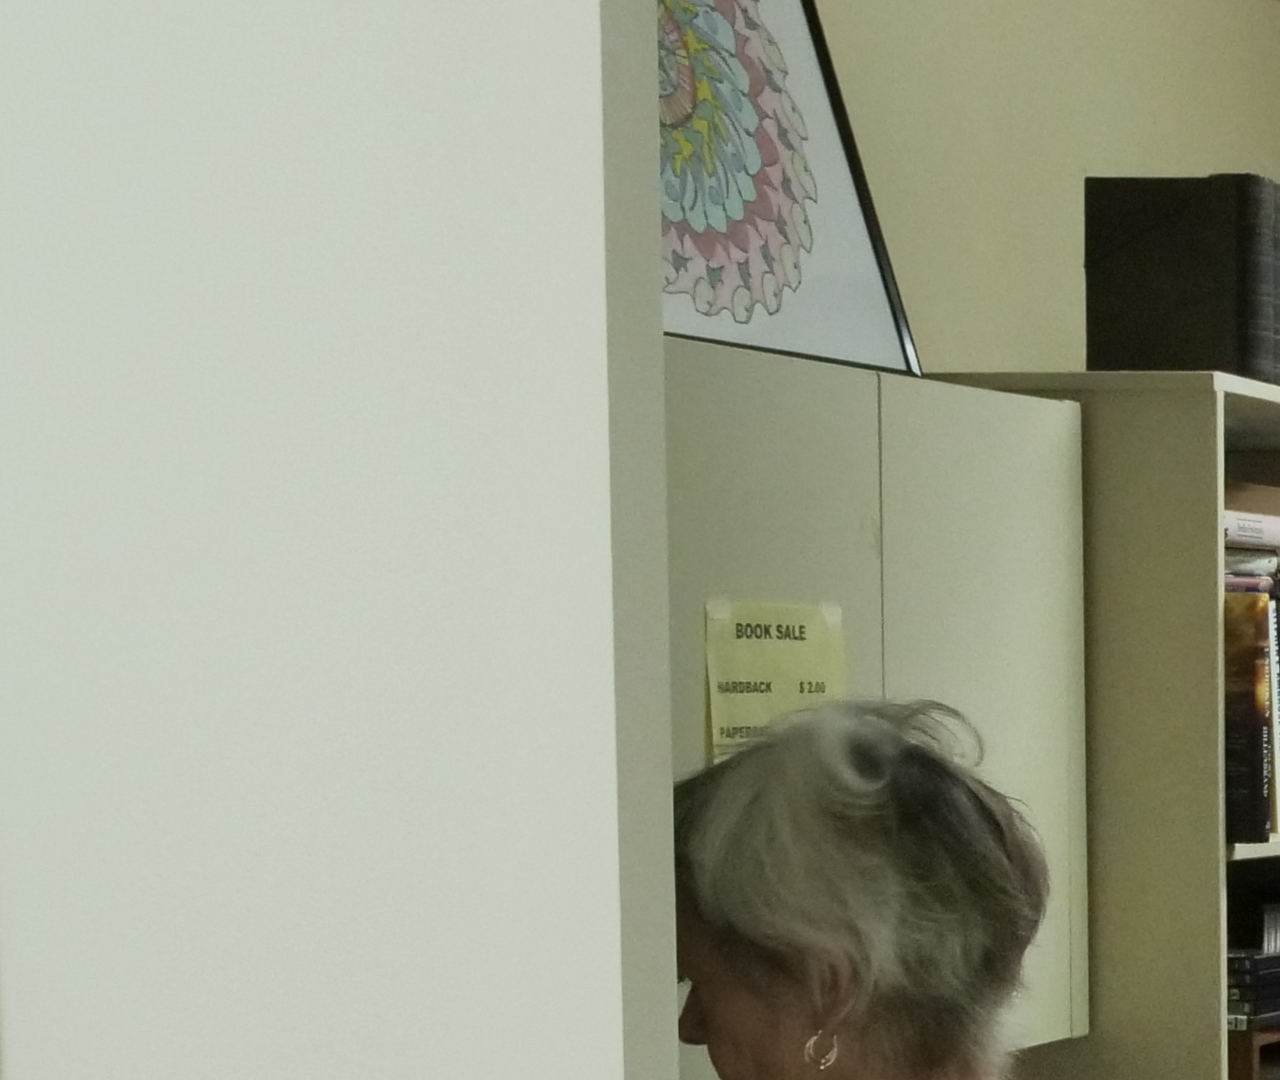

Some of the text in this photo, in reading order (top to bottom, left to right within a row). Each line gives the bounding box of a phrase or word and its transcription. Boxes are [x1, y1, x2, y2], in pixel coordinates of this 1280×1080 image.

[735, 623, 807, 641] BOOK SALE
[716, 681, 772, 693] HARDBACK
[807, 681, 827, 693] 2.00
[719, 725, 769, 738] PAPER
